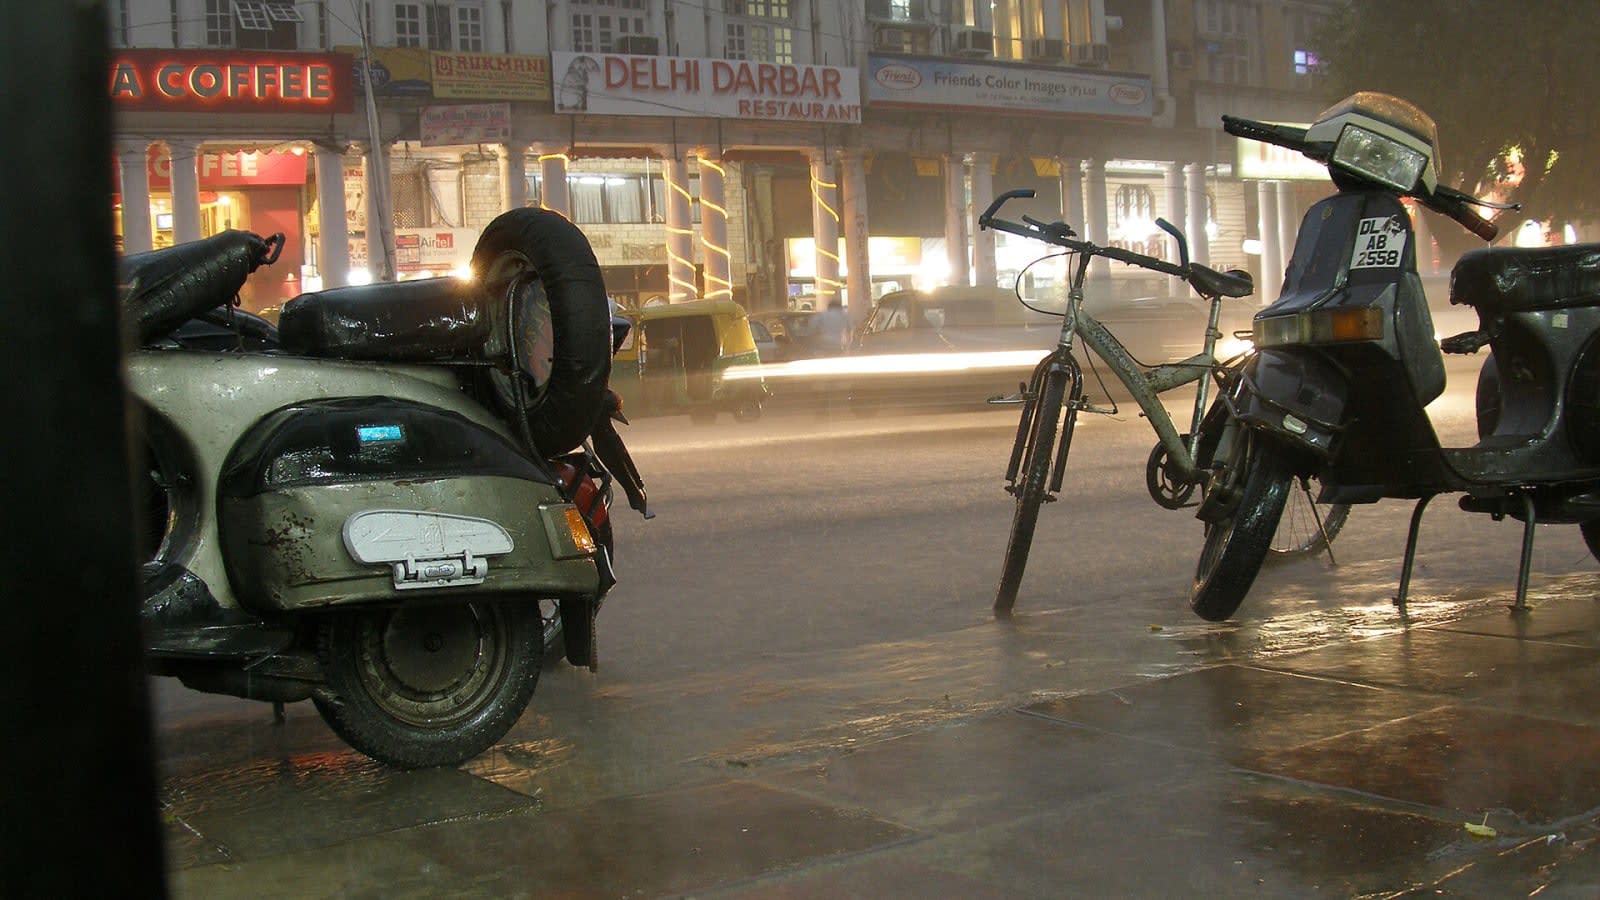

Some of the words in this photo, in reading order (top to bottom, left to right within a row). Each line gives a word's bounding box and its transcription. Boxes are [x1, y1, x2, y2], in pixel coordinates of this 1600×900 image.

[457, 56, 545, 73] RUKMANI
[156, 63, 330, 99] COFFEE
[604, 56, 700, 93] DELHI
[711, 61, 841, 99] DARBAR
[934, 71, 982, 88] Friends
[985, 75, 1019, 89] Color
[1024, 78, 1067, 95] Images
[738, 99, 862, 120] RESTAURANT
[1360, 219, 1380, 235] DL
[1366, 235, 1388, 250] AB
[1356, 250, 1399, 267] 2558
